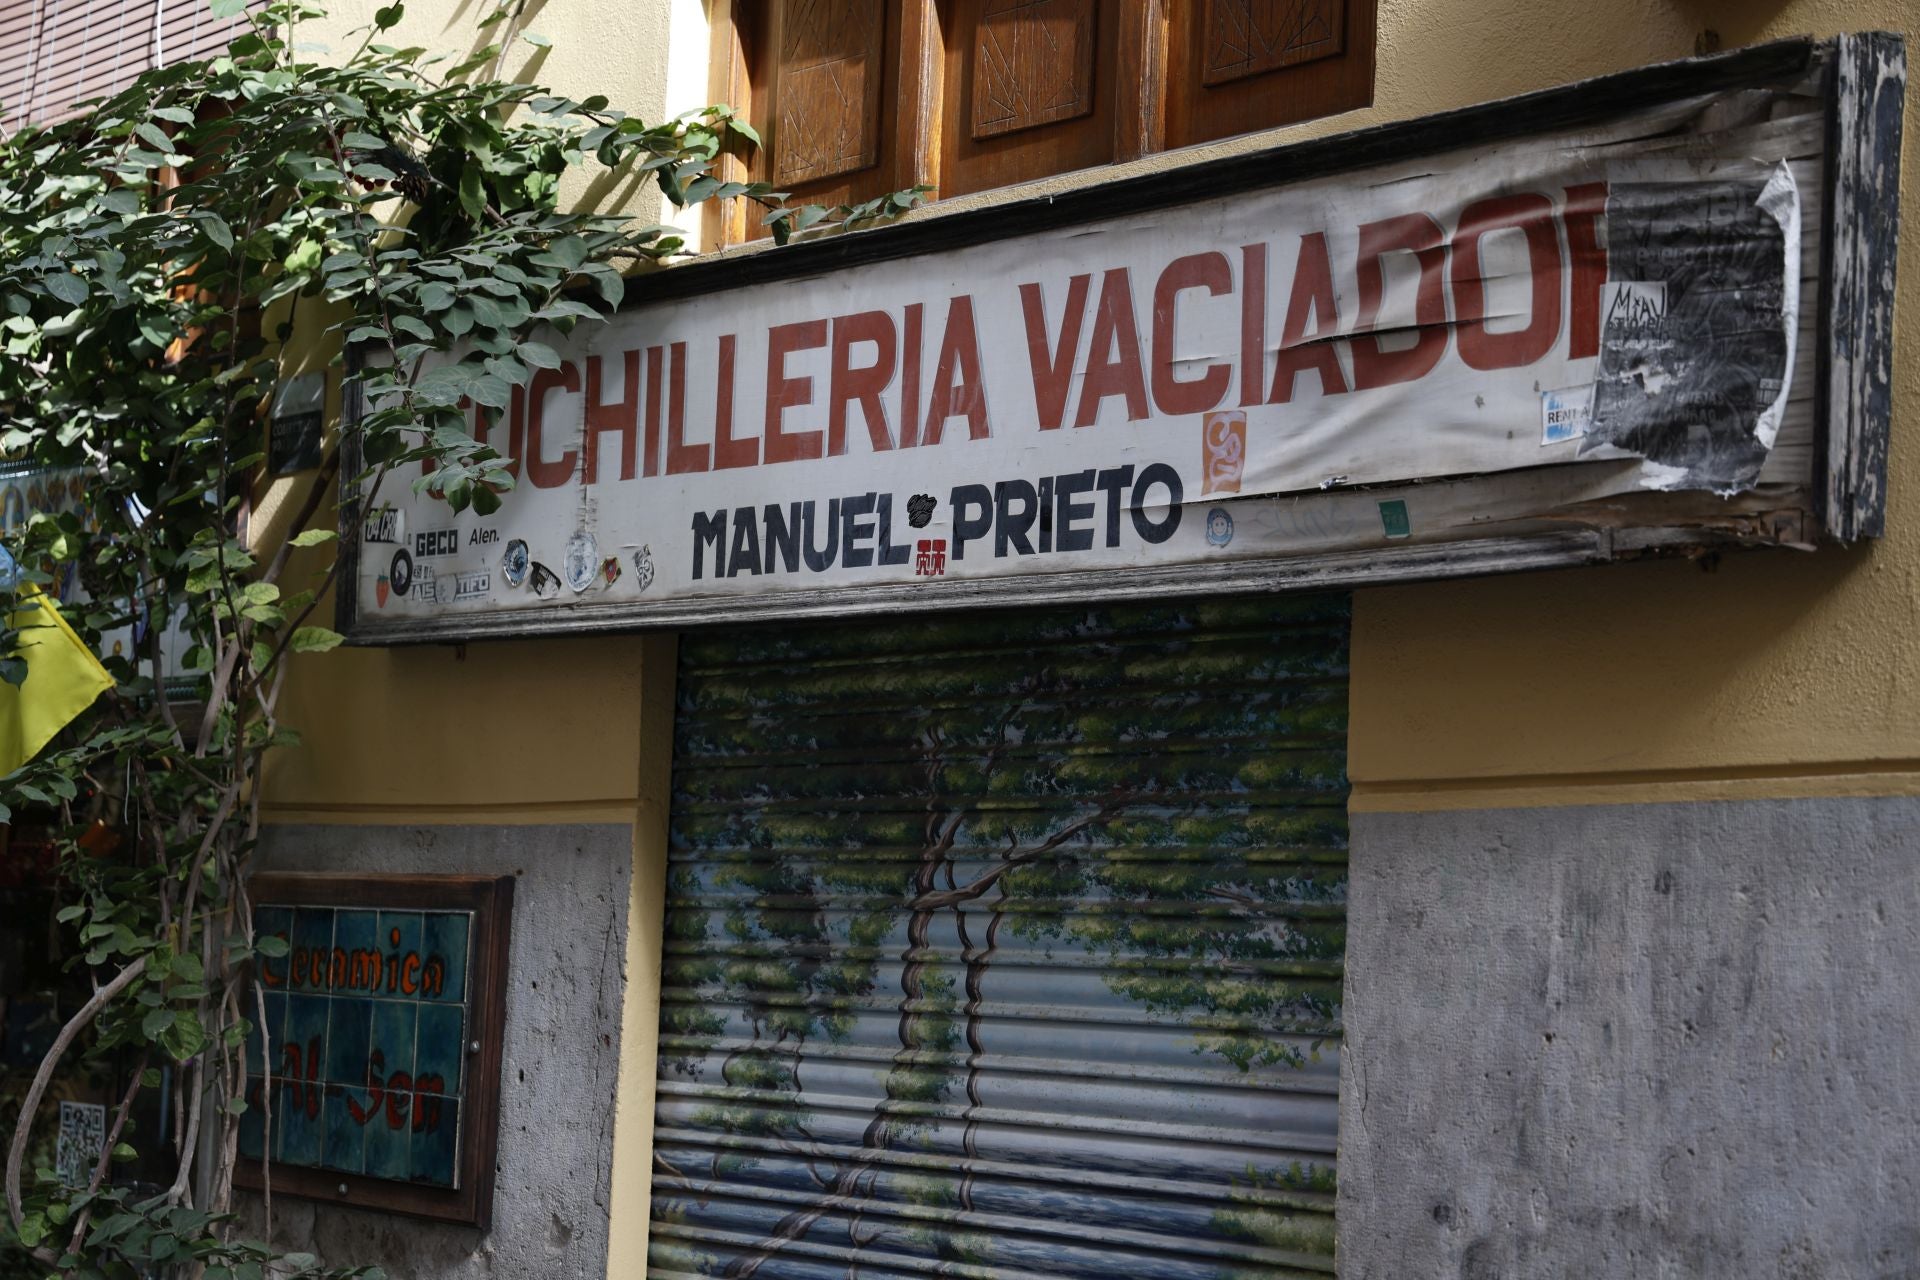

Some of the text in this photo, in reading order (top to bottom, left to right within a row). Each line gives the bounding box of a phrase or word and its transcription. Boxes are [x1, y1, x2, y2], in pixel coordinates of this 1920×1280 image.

[691, 491, 911, 580] MANUEL
[949, 462, 1184, 560] PRIETO
[469, 528, 500, 545] Alen.
[458, 575, 488, 593] TIFO
